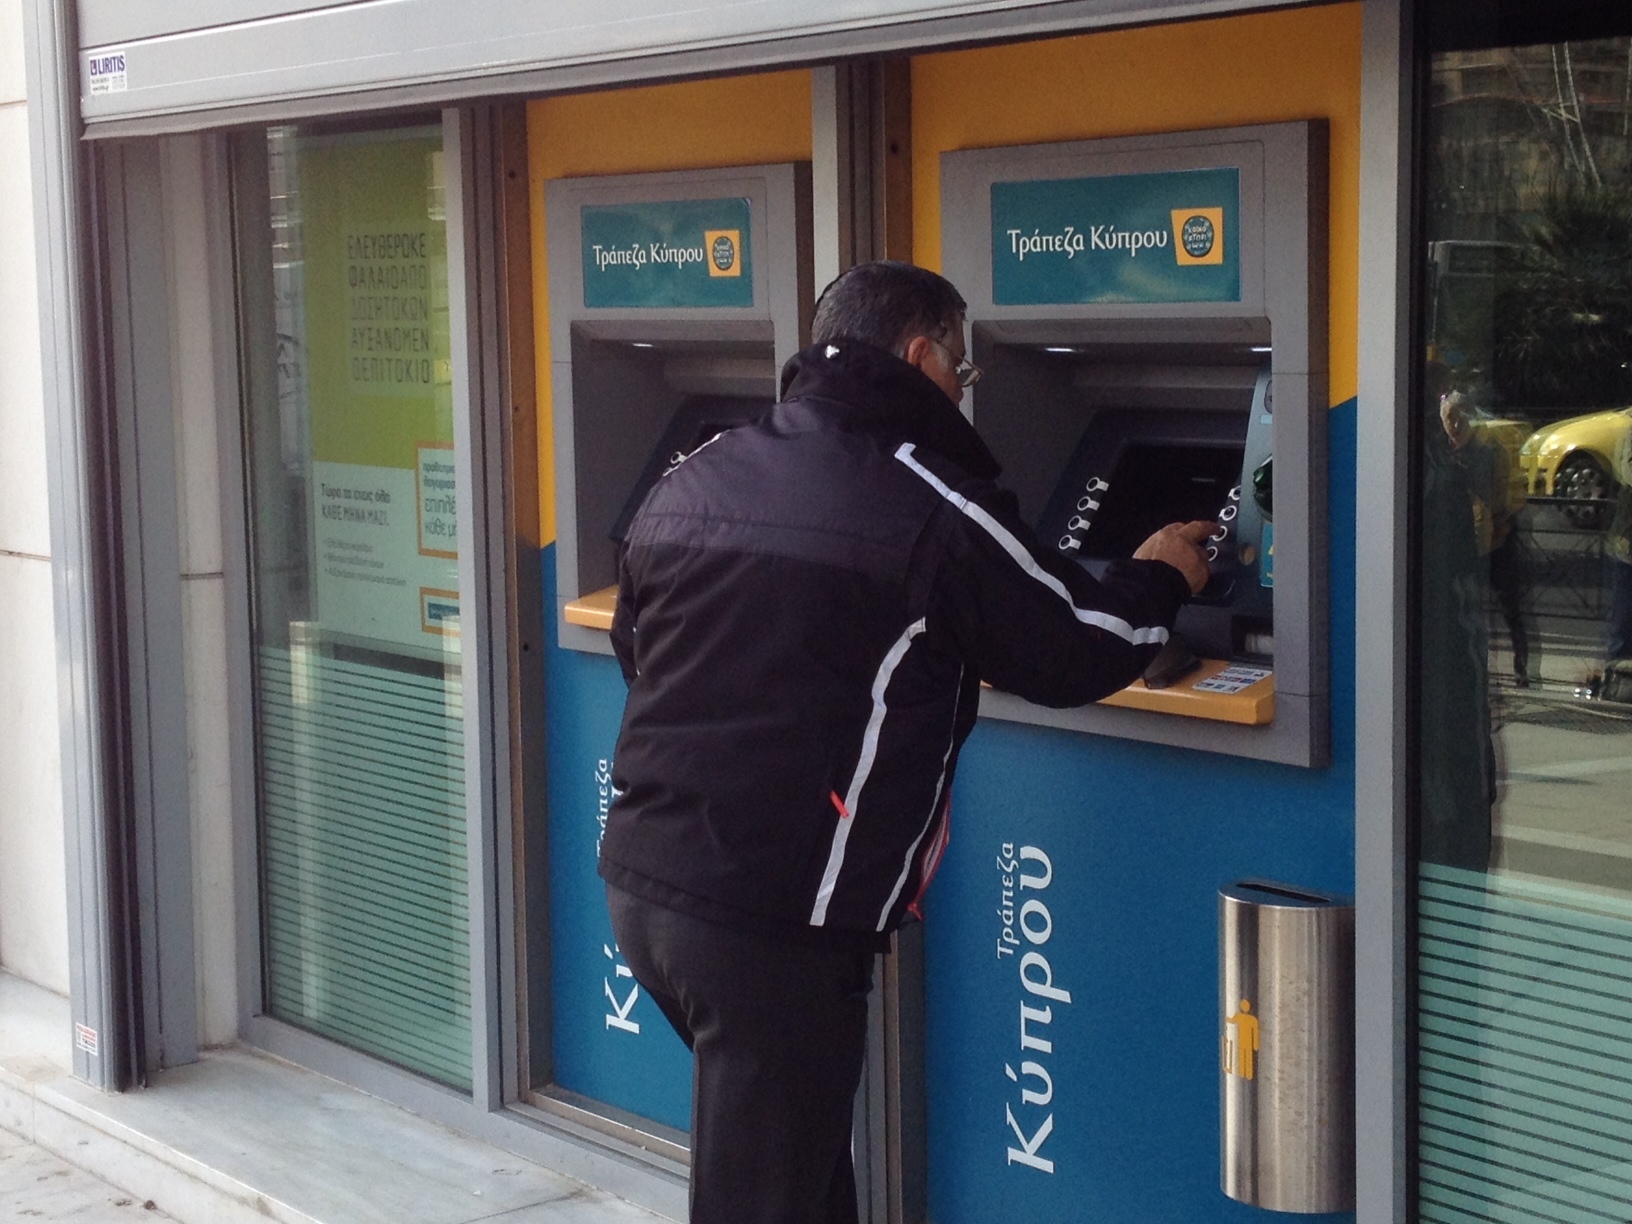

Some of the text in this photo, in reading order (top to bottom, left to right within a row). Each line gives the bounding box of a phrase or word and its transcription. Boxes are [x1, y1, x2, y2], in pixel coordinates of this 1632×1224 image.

[97, 55, 125, 75] LIRITIS
[592, 243, 647, 272] Τράπεζα
[650, 242, 704, 270] Κύπρου
[1006, 225, 1168, 261] Τράπεζα Κύπρου
[997, 841, 1020, 960] Τράπεζα
[1005, 845, 1072, 1174] Κύπρου
